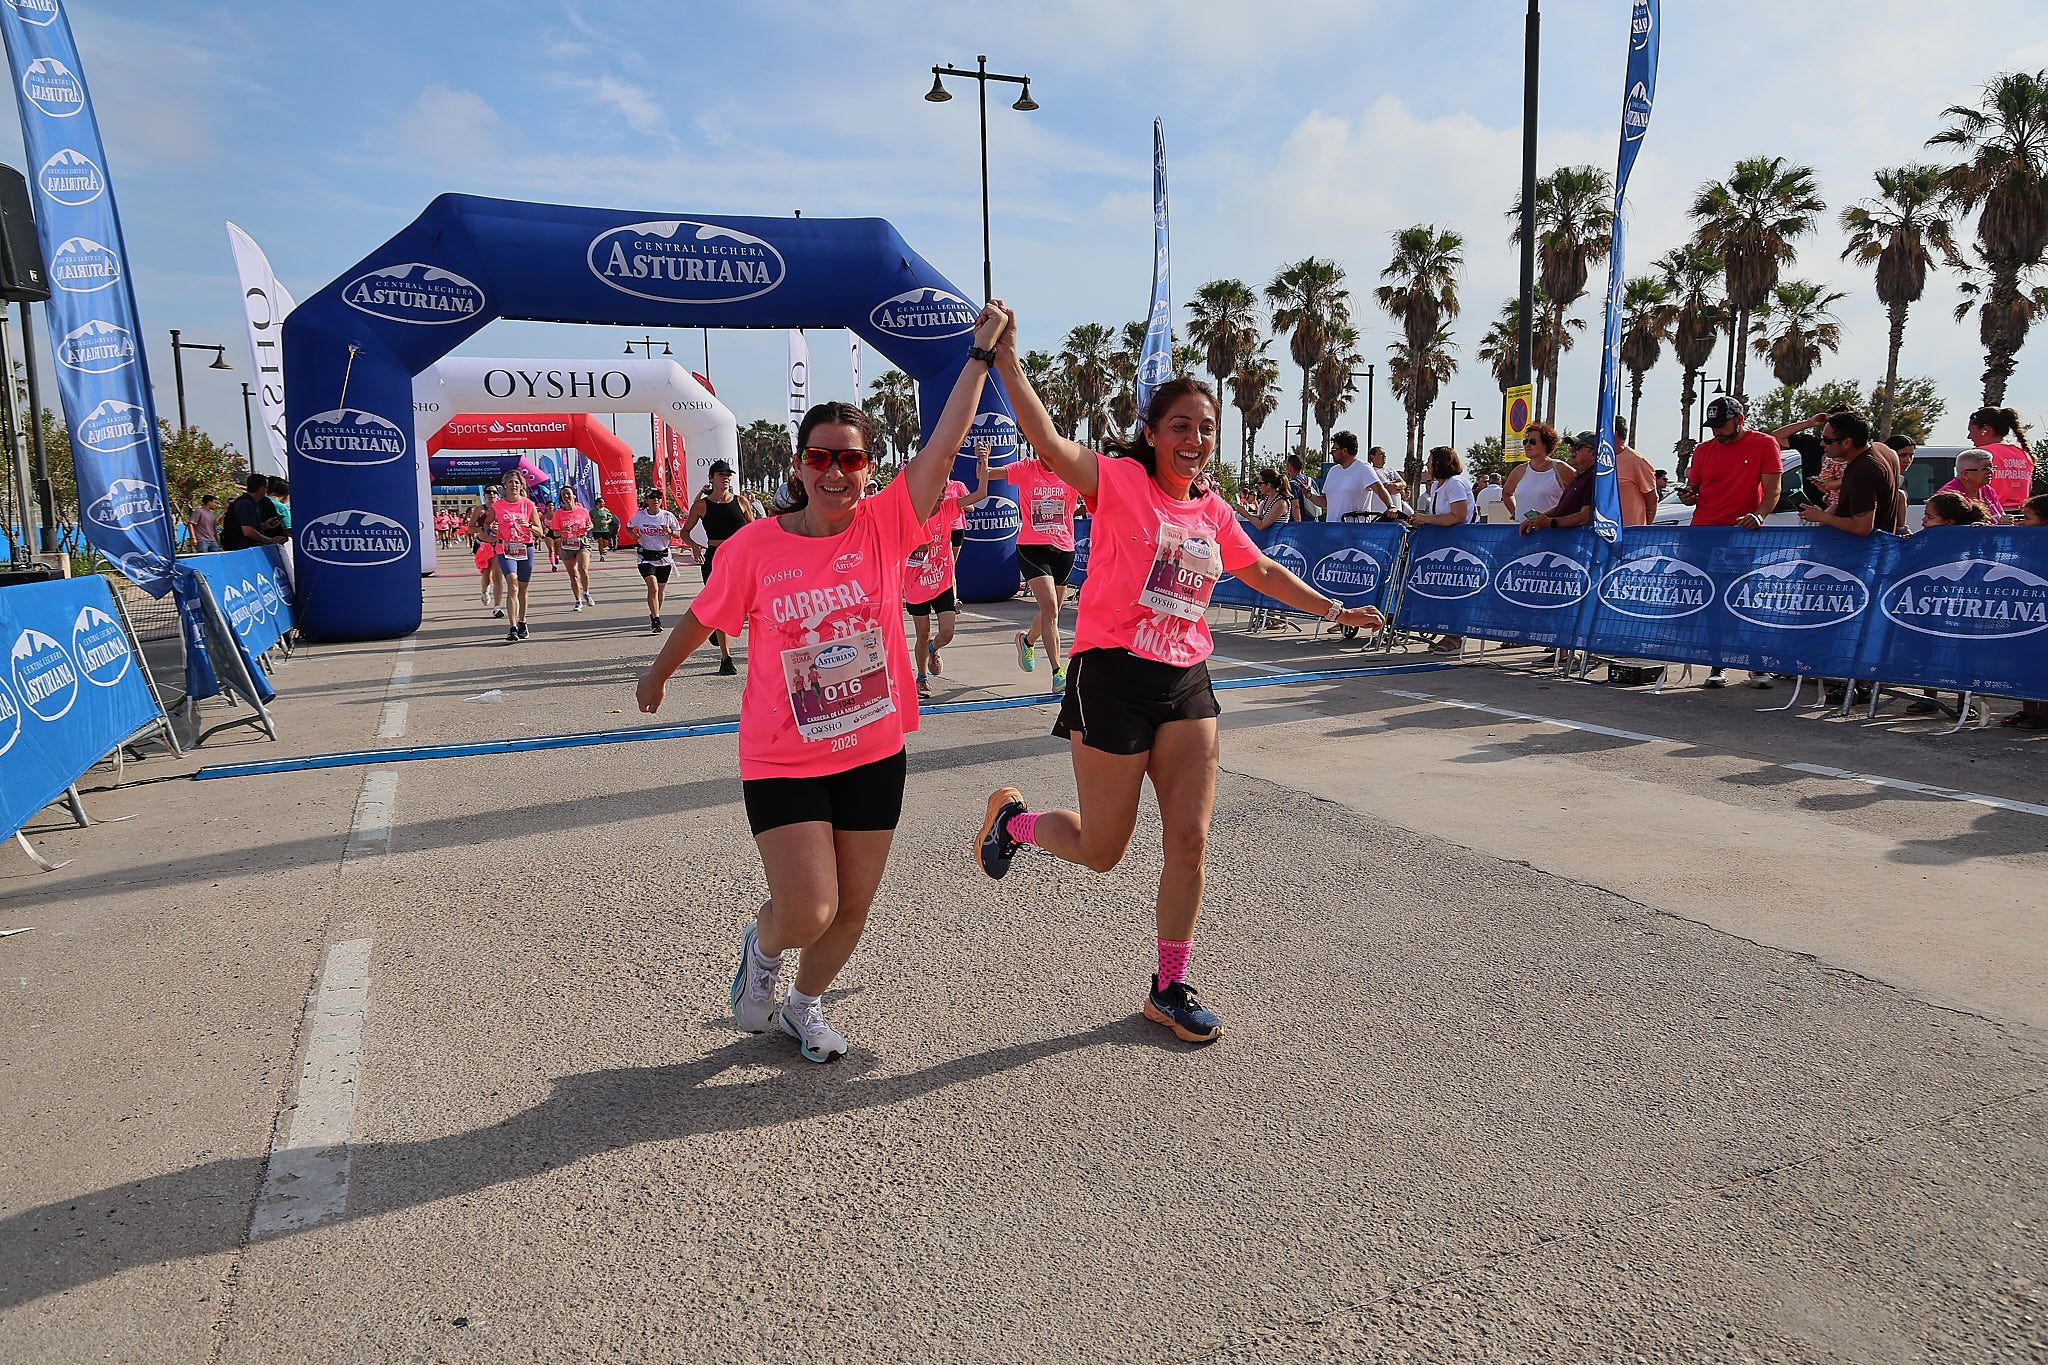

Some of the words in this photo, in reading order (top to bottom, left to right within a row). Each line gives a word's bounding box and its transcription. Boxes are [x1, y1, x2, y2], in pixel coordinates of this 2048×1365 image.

[634, 240, 697, 254] CENTRAL
[703, 245, 765, 257] LECHERA
[603, 241, 772, 284] ASTURIANA
[351, 282, 475, 313] ASTURIANA
[375, 281, 424, 290] CENTRAL
[428, 284, 474, 296] LECHERA
[879, 308, 976, 328] ASTURIANA
[897, 305, 934, 313] CENTRAL
[483, 369, 632, 399] OYSHO
[672, 401, 713, 410] OYSHO
[359, 428, 398, 437] LECHERA
[448, 422, 488, 436] Sports
[506, 422, 567, 433] Santander
[300, 429, 401, 453] ASTURIANA
[2004, 458, 2027, 469] SOMOS
[1033, 486, 1065, 497] CARRERA
[306, 530, 406, 552] ASTURIANA
[763, 568, 804, 586] OYSHO
[919, 571, 944, 587] MUJER
[1177, 568, 1204, 588] 016
[1316, 563, 1375, 587] ASTURIANA
[1409, 564, 1480, 588] ASTURIANA
[1500, 570, 1582, 596] ASTURIANA
[1517, 569, 1548, 577] CENTRAL
[1549, 570, 1582, 579] LECHERA
[1604, 576, 1704, 605] ASTURIANA
[1806, 583, 1854, 592] LECHERA
[1923, 585, 1980, 595] CENTRAL
[1986, 587, 2046, 598] LECHERA
[772, 579, 866, 624] CARRERA
[1150, 596, 1178, 610] OYSHO
[1732, 582, 1855, 613] ASTURIANA
[1891, 586, 2048, 623] ASTURIANA
[818, 650, 857, 667] ASTURIANA
[18, 662, 75, 706] ASTURIANA
[824, 678, 862, 701] 016
[807, 714, 830, 723] CARRERA
[811, 721, 842, 735] OYSHO
[831, 733, 858, 753] 2026
